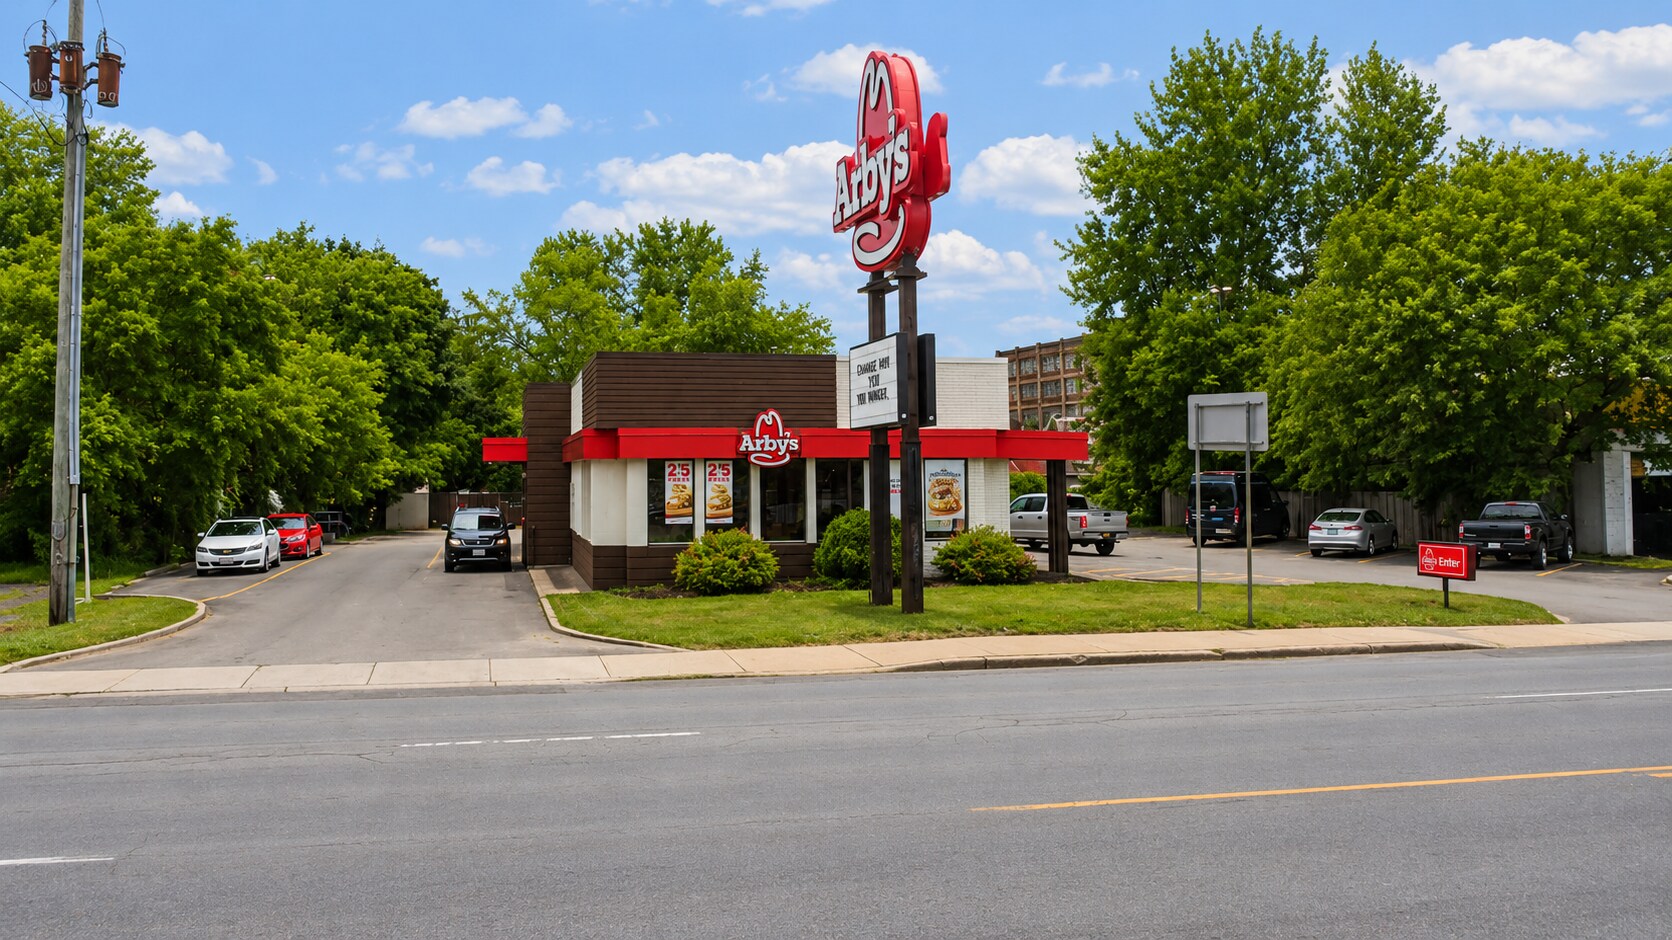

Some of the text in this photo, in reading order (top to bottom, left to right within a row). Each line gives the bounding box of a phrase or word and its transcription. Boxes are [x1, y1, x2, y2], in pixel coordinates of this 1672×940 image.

[834, 114, 910, 226] Arby's
[739, 432, 799, 456] Arby's
[1438, 557, 1461, 568] Enter
